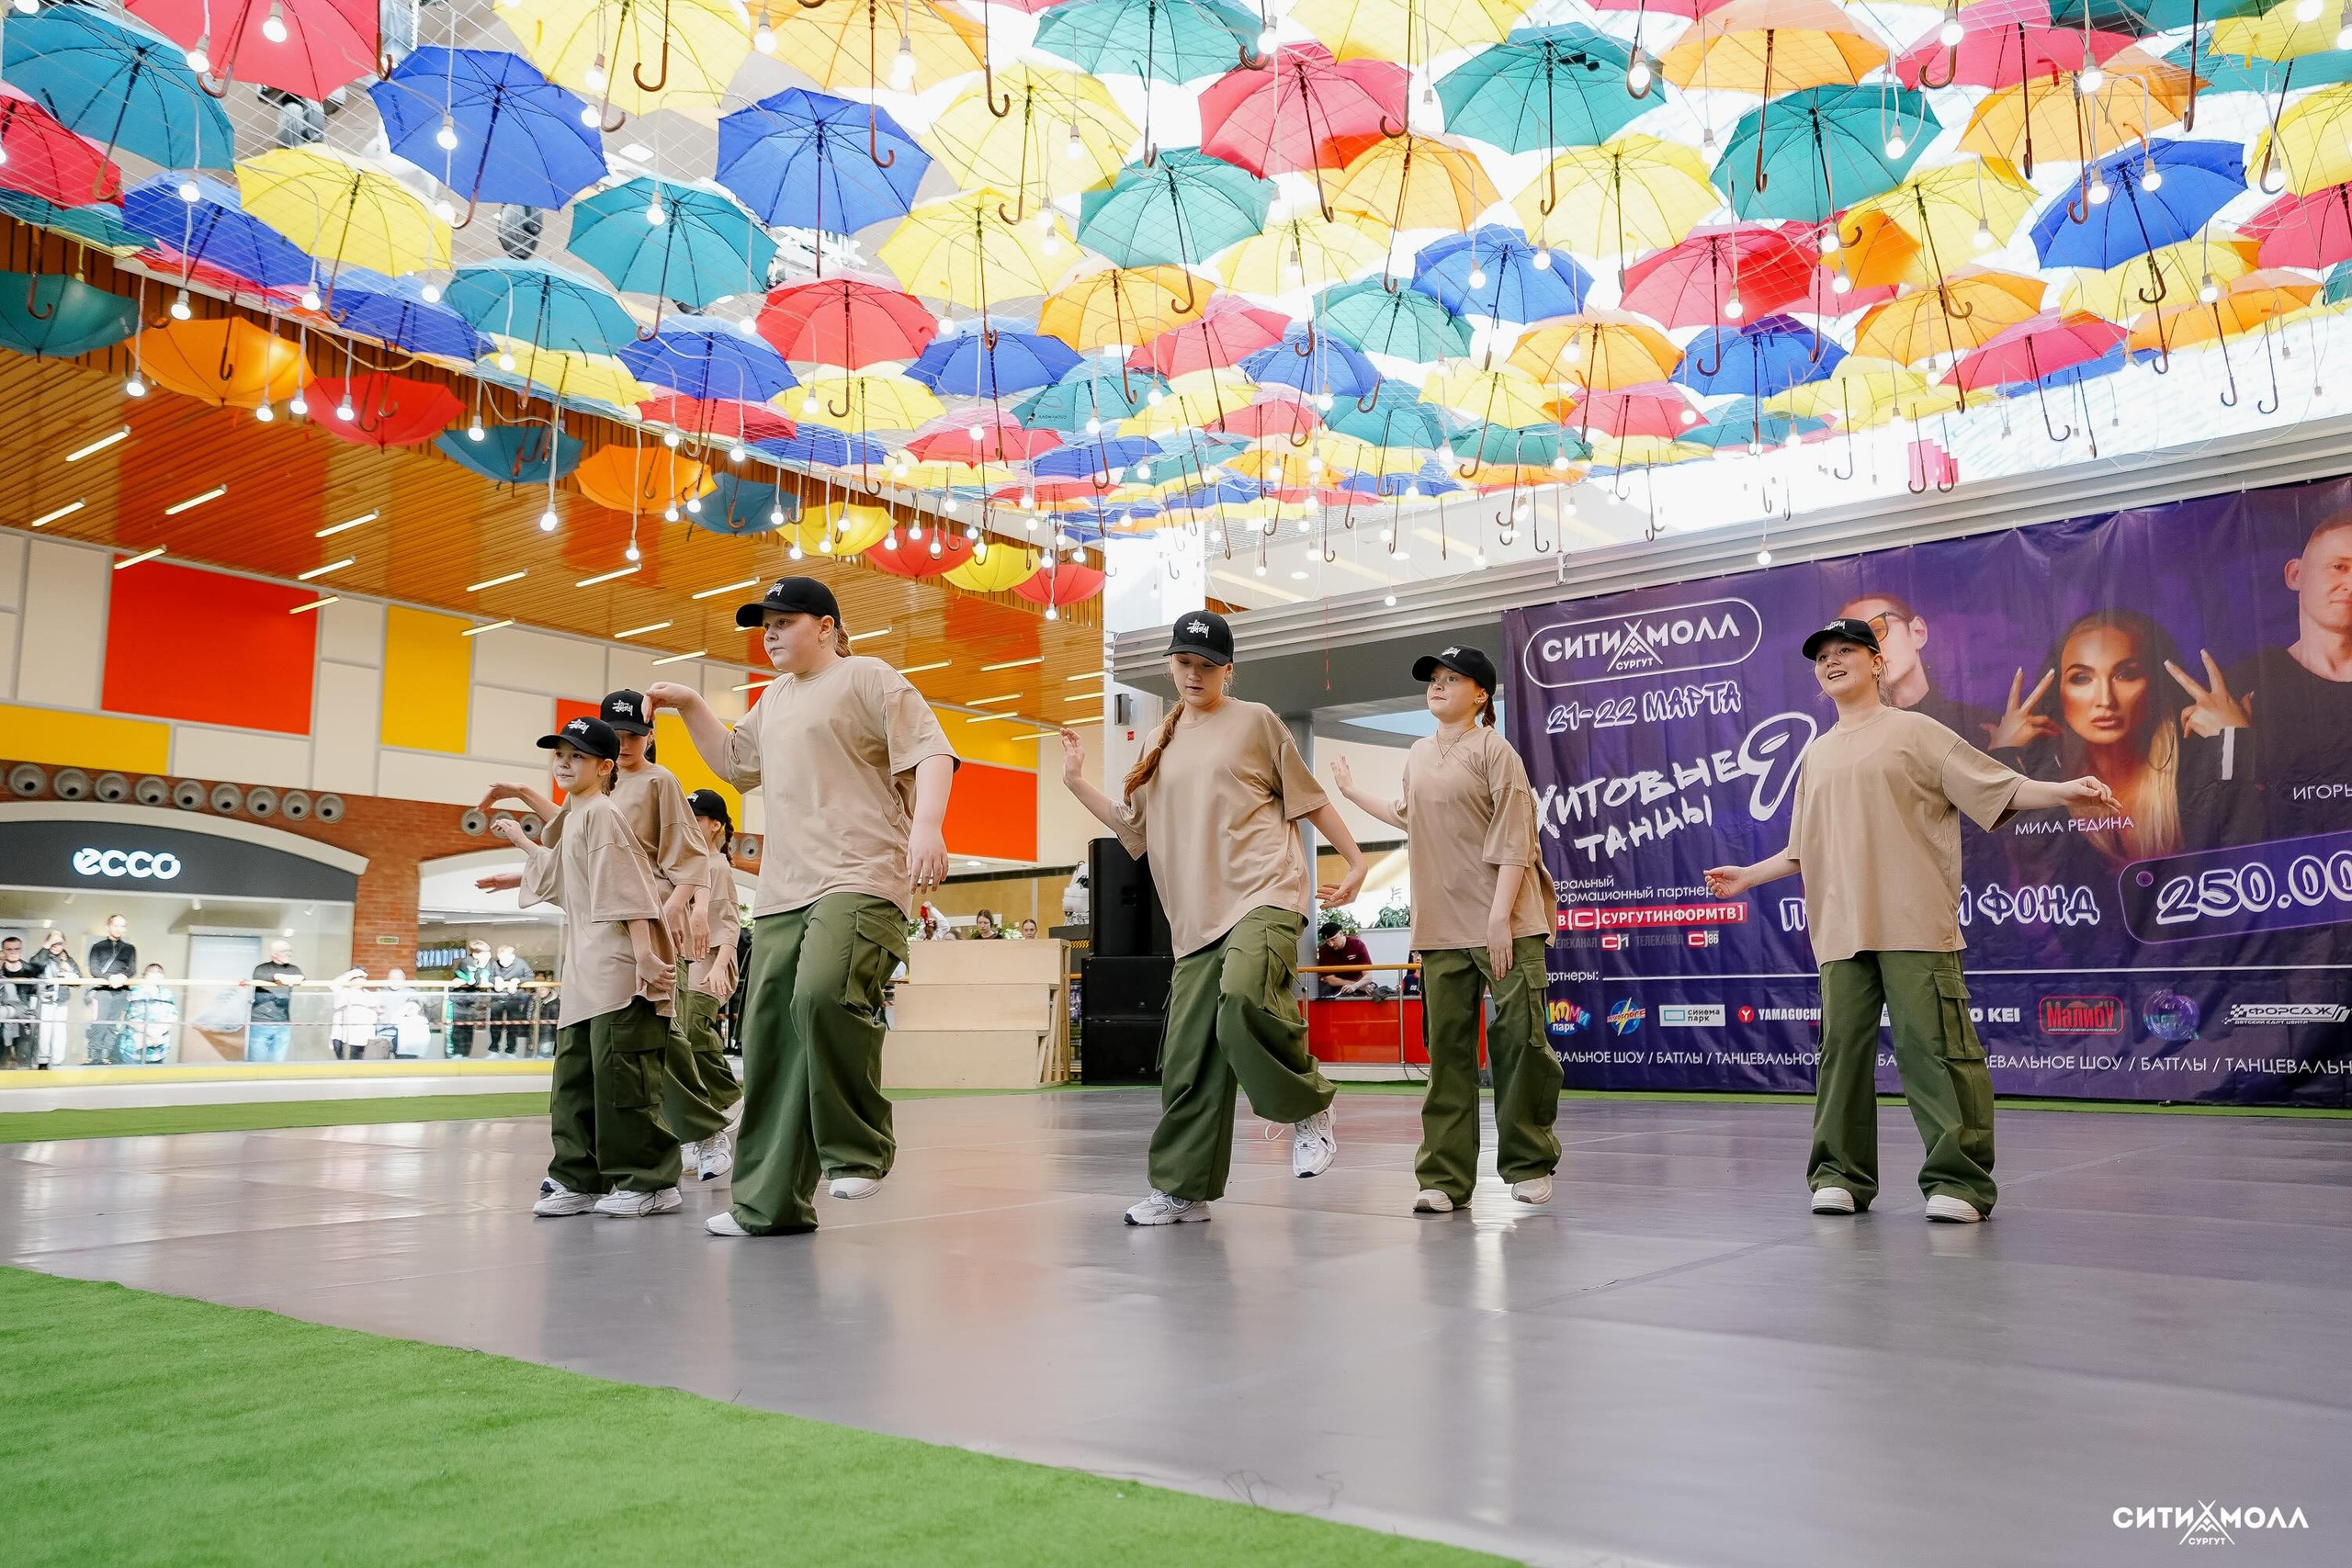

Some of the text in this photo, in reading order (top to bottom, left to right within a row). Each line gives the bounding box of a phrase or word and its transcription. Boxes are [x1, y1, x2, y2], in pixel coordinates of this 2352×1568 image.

[1542, 613, 1740, 662] СИТИ МОЛЛ
[1615, 658, 1654, 671] СУРГУТ
[1546, 680, 1742, 735] 21-22 МАРТА
[1532, 750, 1746, 839] ХИТОВЫЕ
[2292, 783, 2352, 801] ИГОРЬ
[1574, 795, 1713, 863] ТАНЦЫ
[2015, 815, 2135, 836] МИЛА РЕДИНА
[72, 847, 182, 880] ecco
[2155, 849, 2352, 926] 250.00
[1635, 934, 1684, 946] ТЕЛЕКАНАЛ
[1687, 1016, 1711, 1024] парк
[1758, 1008, 1822, 1021] YAMAGUCHI
[2247, 1006, 2333, 1016] ФОРСАЖ
[1552, 1022, 1576, 1033] парк
[1613, 1051, 1645, 1065] ШОУ
[1657, 1051, 1703, 1065] БАТТЛЫ
[1714, 1052, 1821, 1066] ТАНЦЕВАЛЬНОЕ
[1984, 1055, 2075, 1070] ЕВАЛЬНОЕ
[2079, 1055, 2123, 1071] ШОУ
[2141, 1057, 2207, 1072] БАТТЛЫ
[2224, 1057, 2352, 1075] ТАНЦЕВАЛЬН
